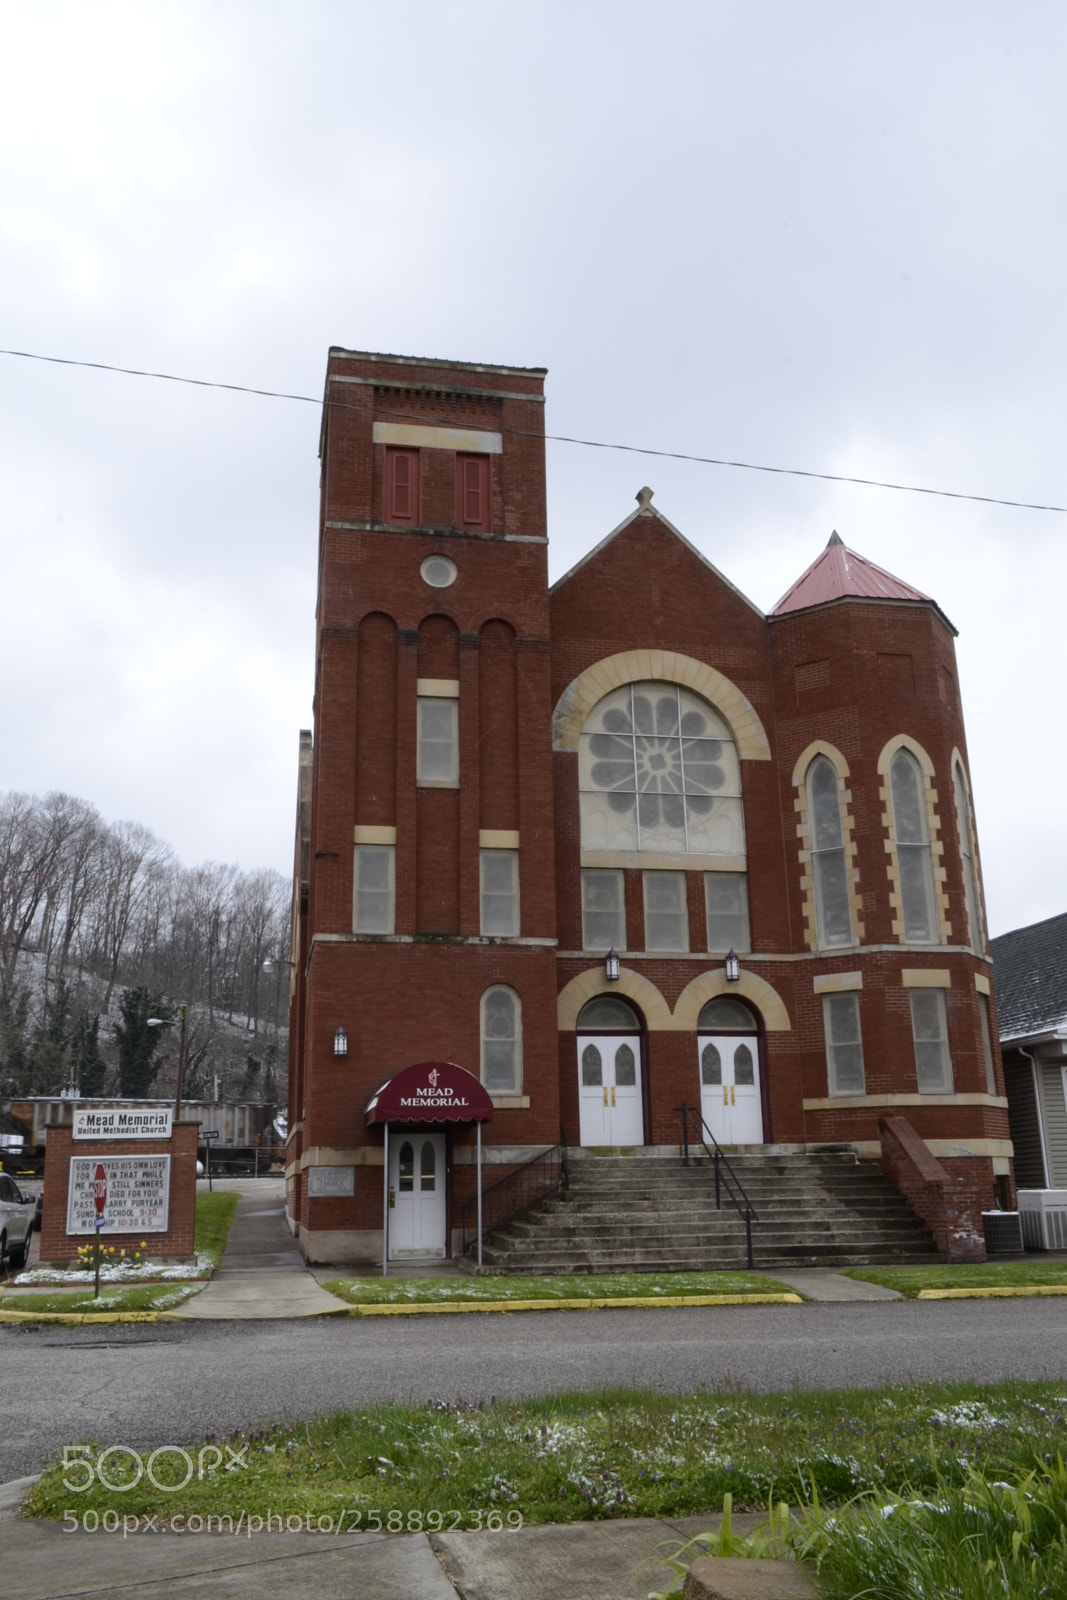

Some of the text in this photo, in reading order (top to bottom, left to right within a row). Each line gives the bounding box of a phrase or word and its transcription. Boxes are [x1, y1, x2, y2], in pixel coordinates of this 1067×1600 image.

[416, 1088, 454, 1096] MEAD
[400, 1098, 469, 1106] MEMORIAL
[86, 1113, 168, 1126] Mead Memorial
[92, 1162, 120, 1170] POVES
[120, 1162, 132, 1170] HIS
[134, 1161, 148, 1169] OWN
[150, 1160, 166, 1168] LOVE
[94, 1179, 106, 1198] STOP
[134, 1180, 164, 1188] SINNERS
[131, 1198, 164, 1207] PURYEAR
[140, 1208, 158, 1216] 9:30
[81, 1219, 115, 1228] WORHIP
[118, 1218, 138, 1226] 10:30
[147, 1218, 152, 1226] 5
